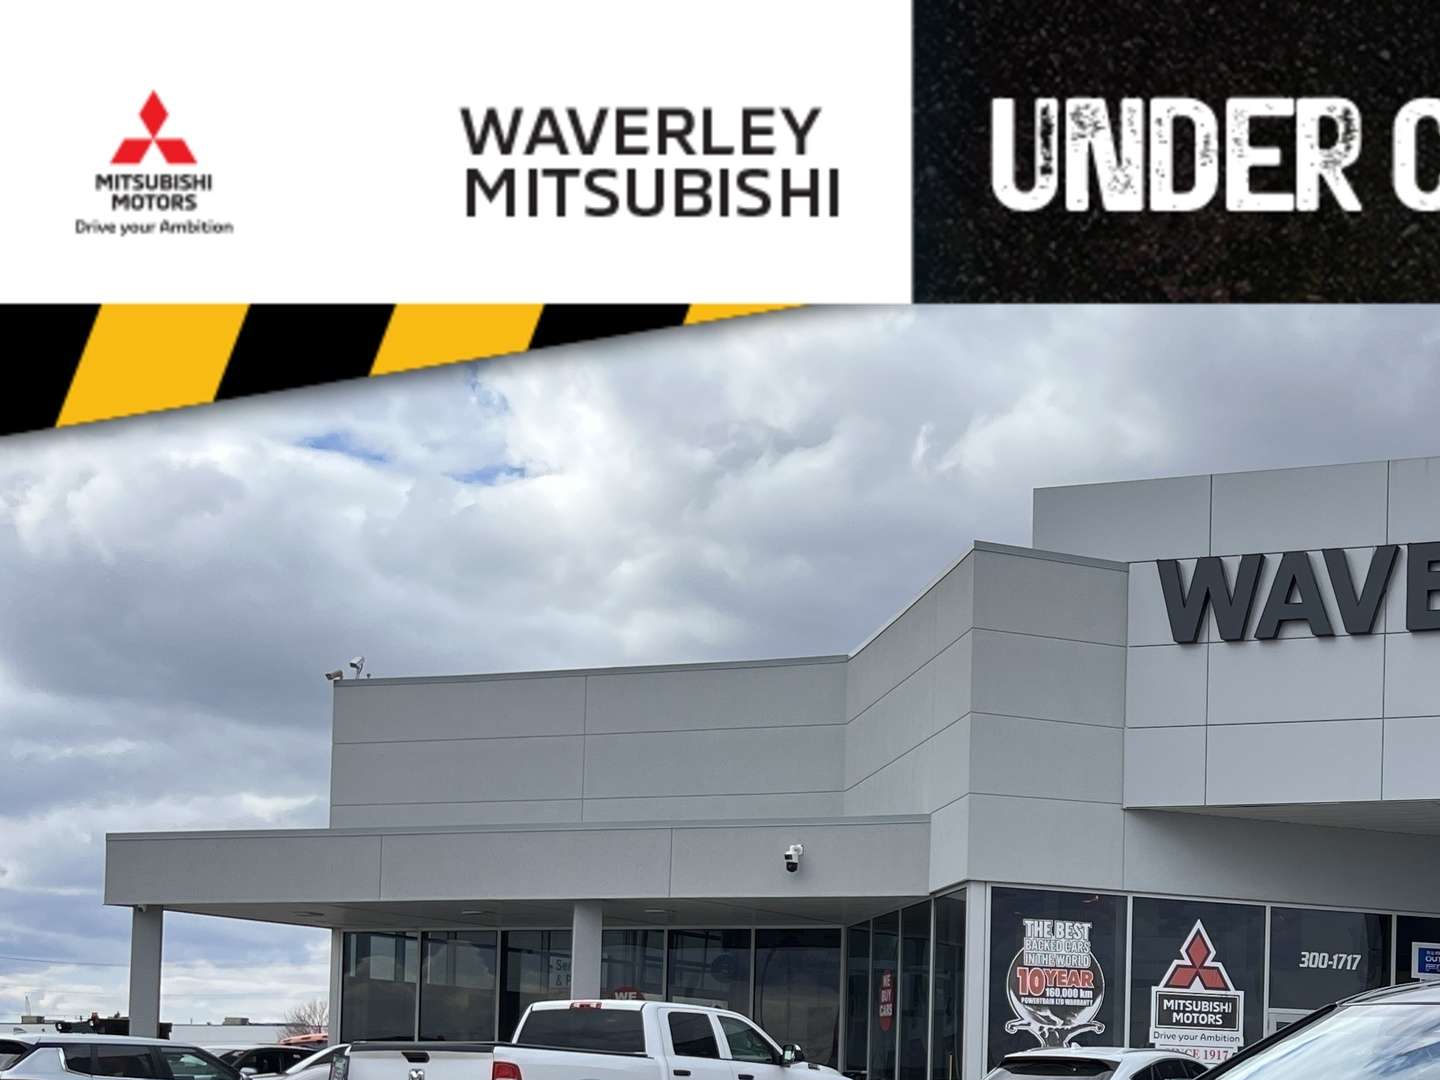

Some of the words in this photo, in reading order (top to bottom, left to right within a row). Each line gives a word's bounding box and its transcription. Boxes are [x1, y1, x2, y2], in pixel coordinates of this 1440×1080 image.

[1023, 920, 1054, 938] THE
[1054, 921, 1092, 941] BEST
[1024, 938, 1064, 953] BACKED
[1063, 940, 1091, 954] CARS
[1034, 952, 1056, 967] THE
[1055, 954, 1091, 968] WORLD
[1299, 951, 1362, 971] 300-1717
[883, 974, 891, 987] WE
[1017, 966, 1045, 997] 10
[1044, 968, 1094, 988] YEAR
[615, 991, 637, 1000] WE
[881, 989, 892, 1002] BUY
[1079, 989, 1093, 999] km
[880, 1003, 892, 1016] CARS
[1163, 999, 1232, 1013] MITSUBISHI
[1172, 1012, 1223, 1025] MOTORS
[1153, 1031, 1177, 1040] Drive
[1200, 1033, 1240, 1043] Ambition
[1204, 1050, 1229, 1060] 1917
